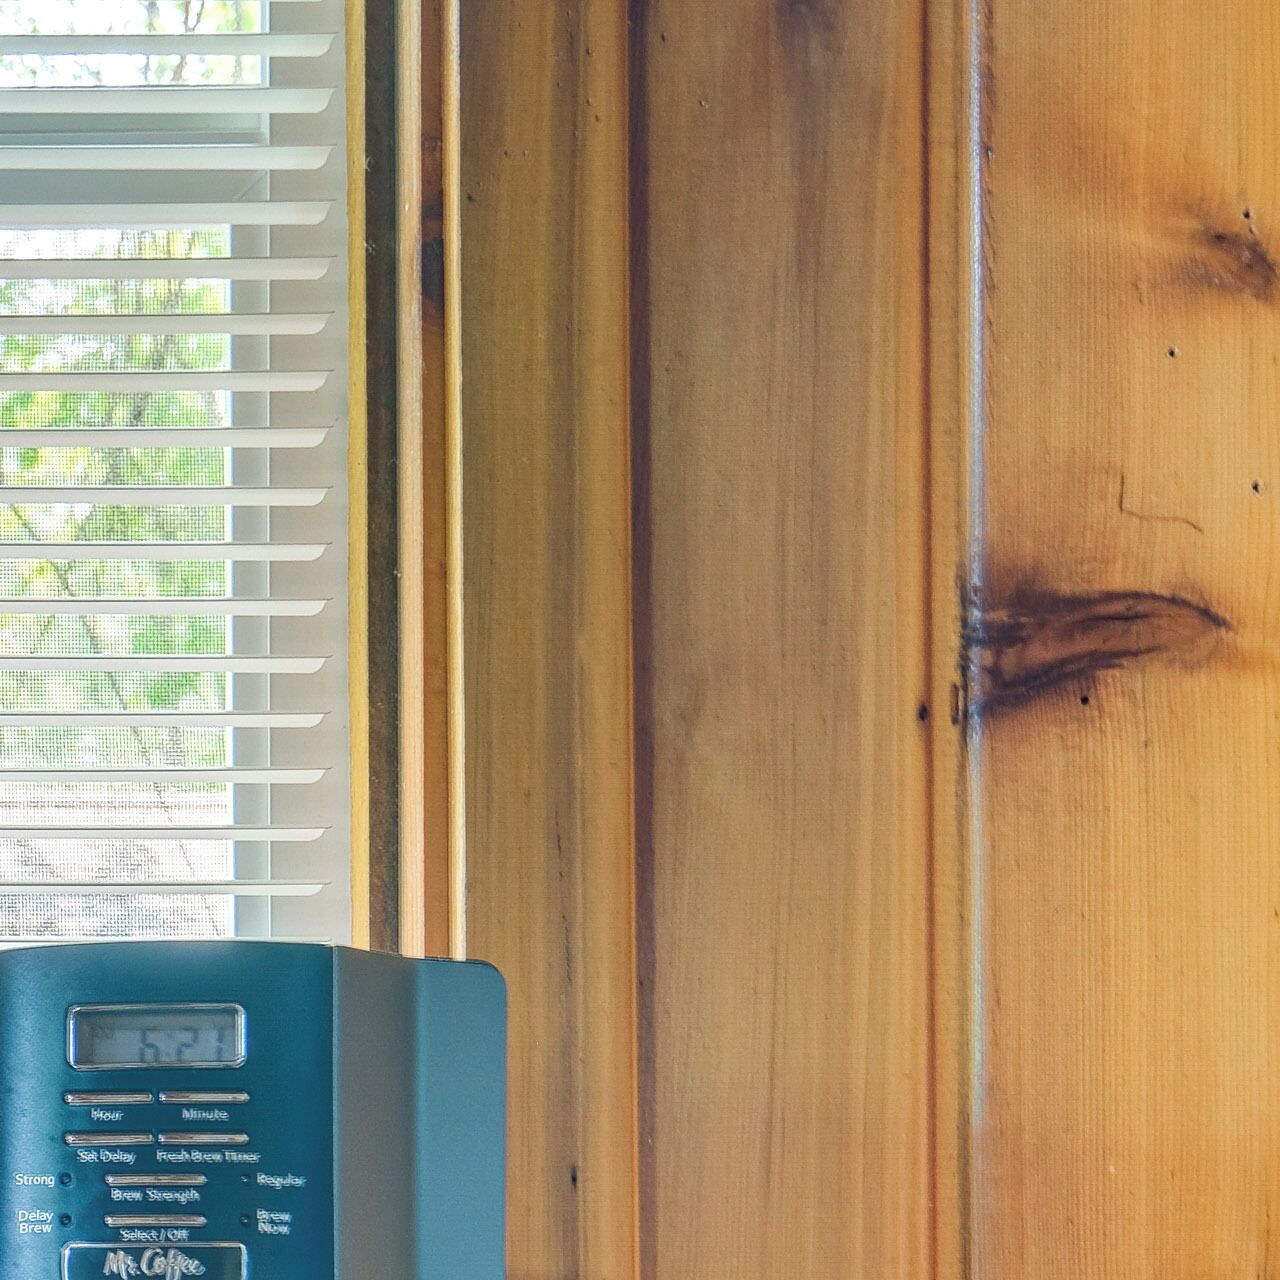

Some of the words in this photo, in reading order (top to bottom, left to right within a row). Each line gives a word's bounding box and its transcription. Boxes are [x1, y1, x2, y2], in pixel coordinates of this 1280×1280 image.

[91, 1108, 125, 1122] Hour
[182, 1108, 229, 1122] Minute
[77, 1150, 99, 1164] Set
[100, 1150, 137, 1166] Delay
[156, 1150, 190, 1164] Fresh
[191, 1151, 222, 1164] Brew
[224, 1151, 261, 1164] Timer
[15, 1174, 55, 1188] Strong
[256, 1174, 306, 1189] Regular
[111, 1188, 143, 1202] Brew
[146, 1188, 201, 1204] Strength
[18, 1210, 54, 1223] Delay
[256, 1209, 292, 1222] Brew
[19, 1222, 53, 1234] Brew
[168, 1228, 190, 1241] Off
[258, 1222, 290, 1235] Now
